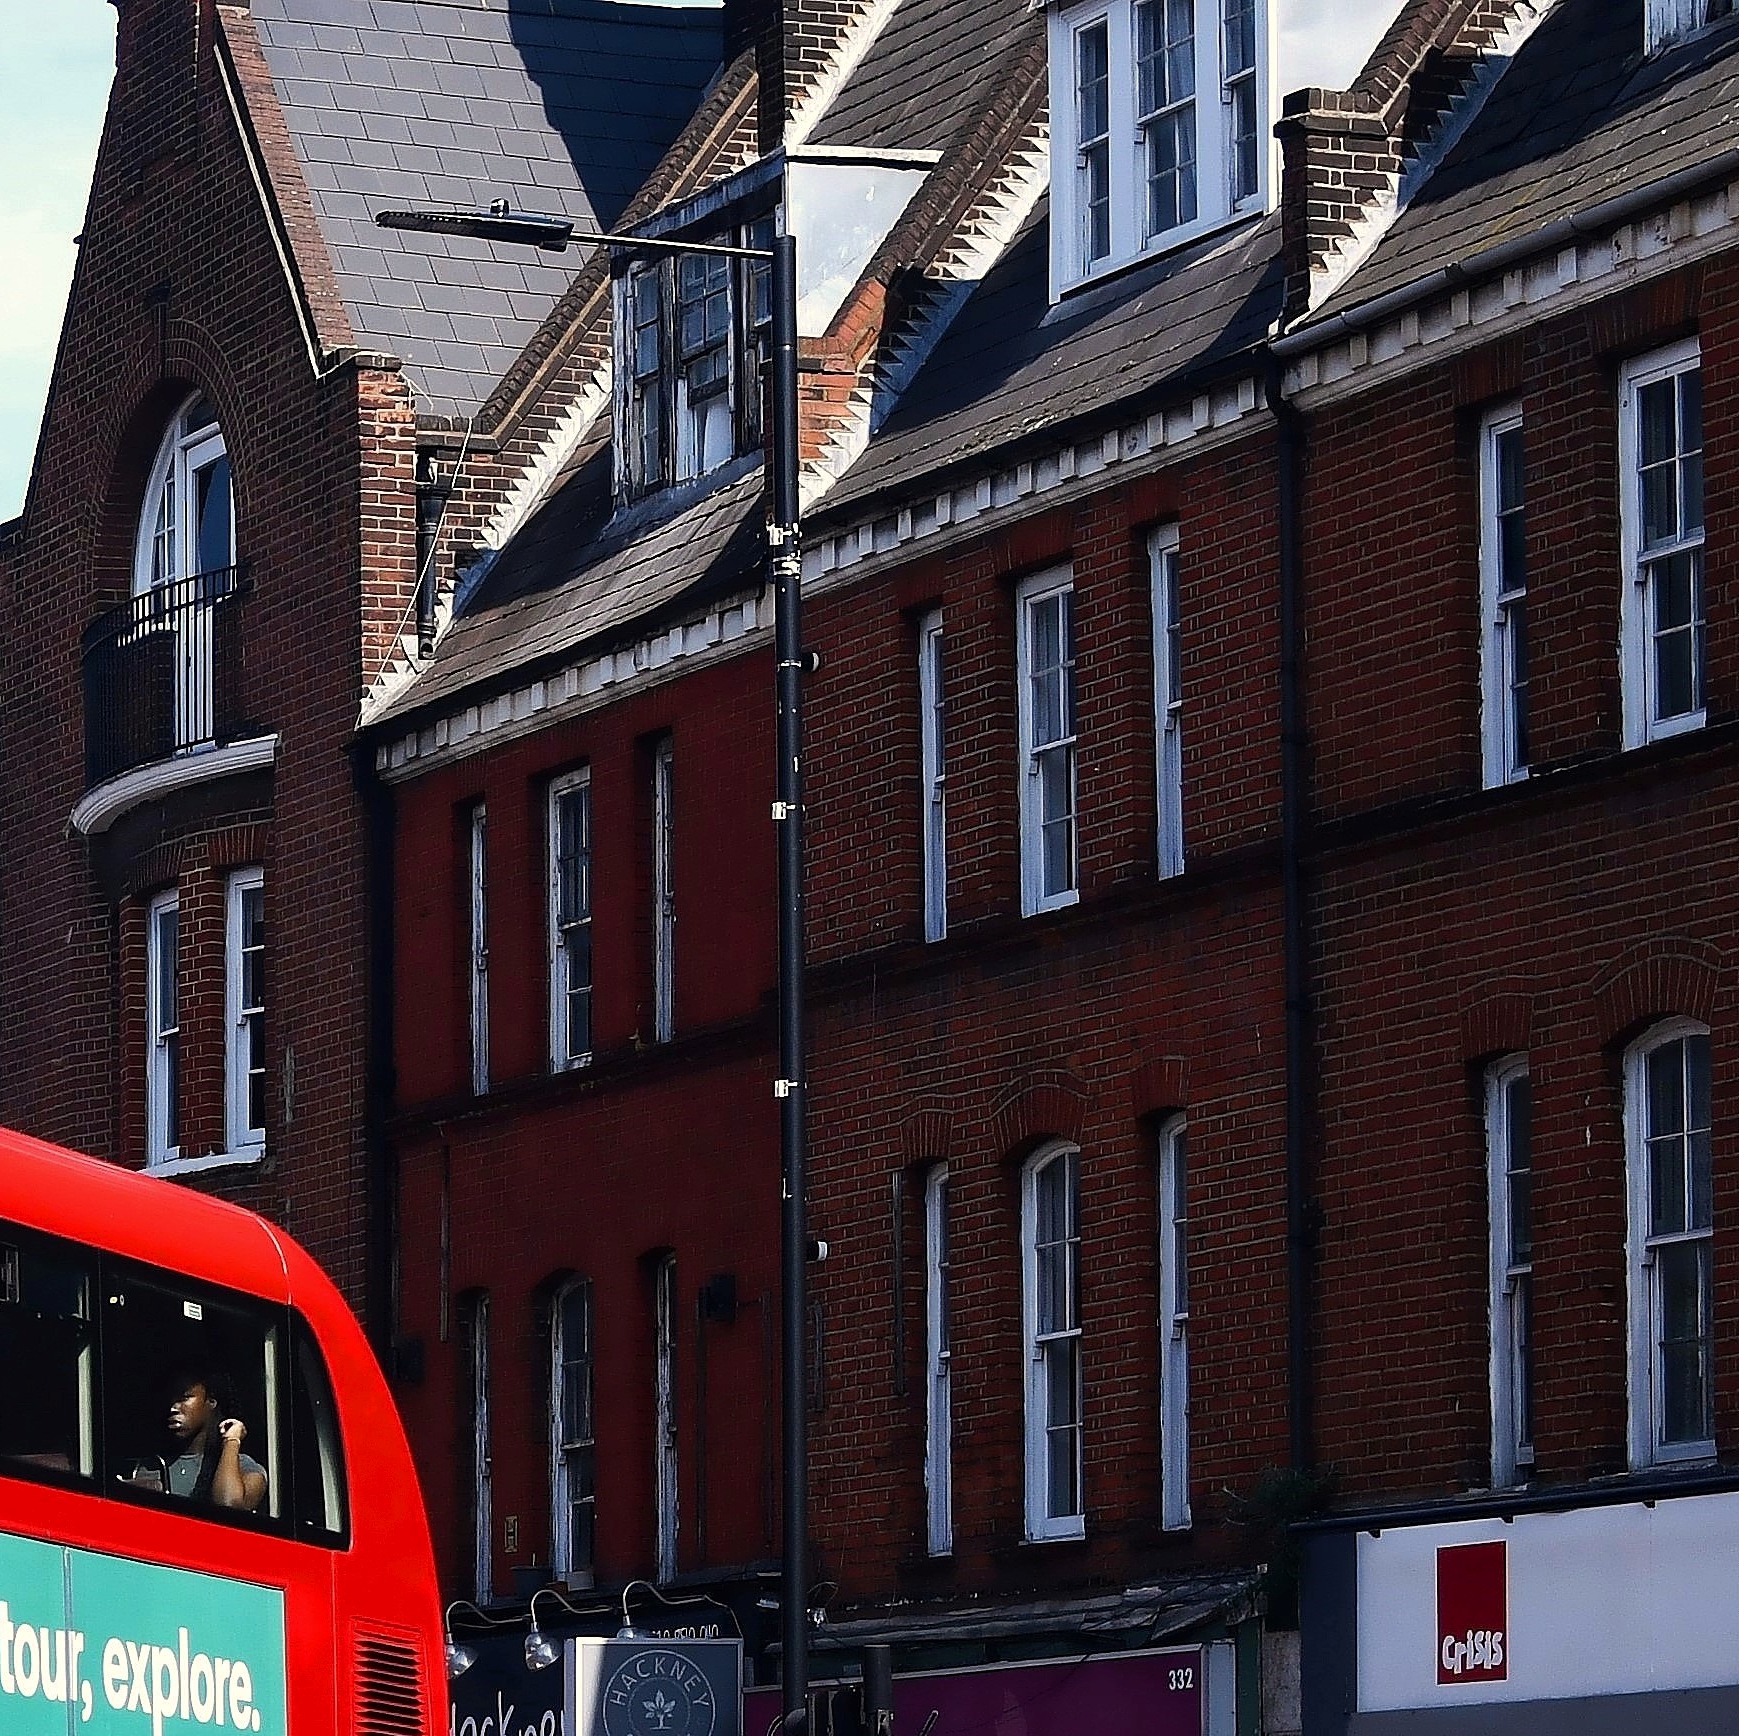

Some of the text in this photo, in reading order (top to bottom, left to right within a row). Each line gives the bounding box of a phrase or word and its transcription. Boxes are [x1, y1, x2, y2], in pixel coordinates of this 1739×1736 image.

[1442, 1629, 1503, 1674] Crisis
[610, 1656, 710, 1707] HACKNEY
[1168, 1668, 1194, 1691] 332
